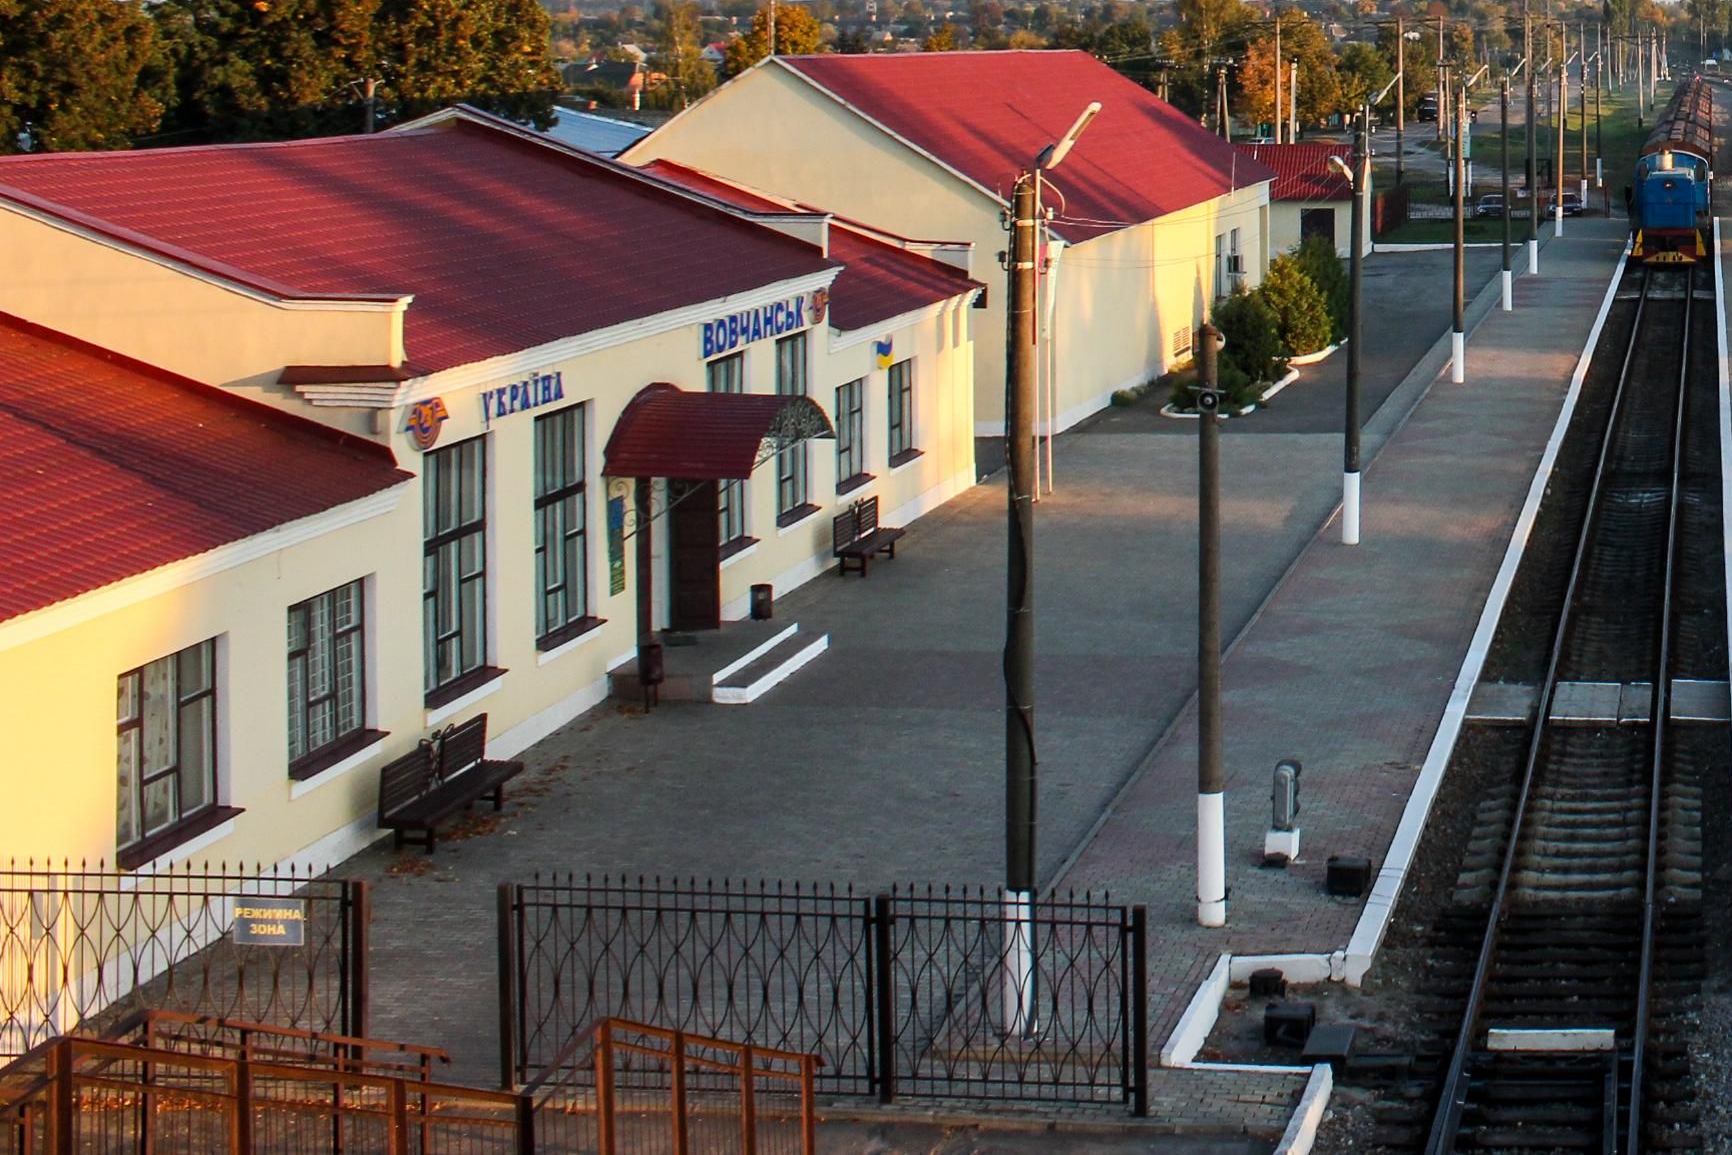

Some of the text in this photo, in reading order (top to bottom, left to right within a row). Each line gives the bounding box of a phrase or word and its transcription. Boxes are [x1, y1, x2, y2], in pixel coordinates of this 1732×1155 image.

[703, 296, 805, 359] ВОВЧАНСЬК
[482, 371, 564, 430] УКРАЇНА
[249, 923, 286, 936] ЗОНА
